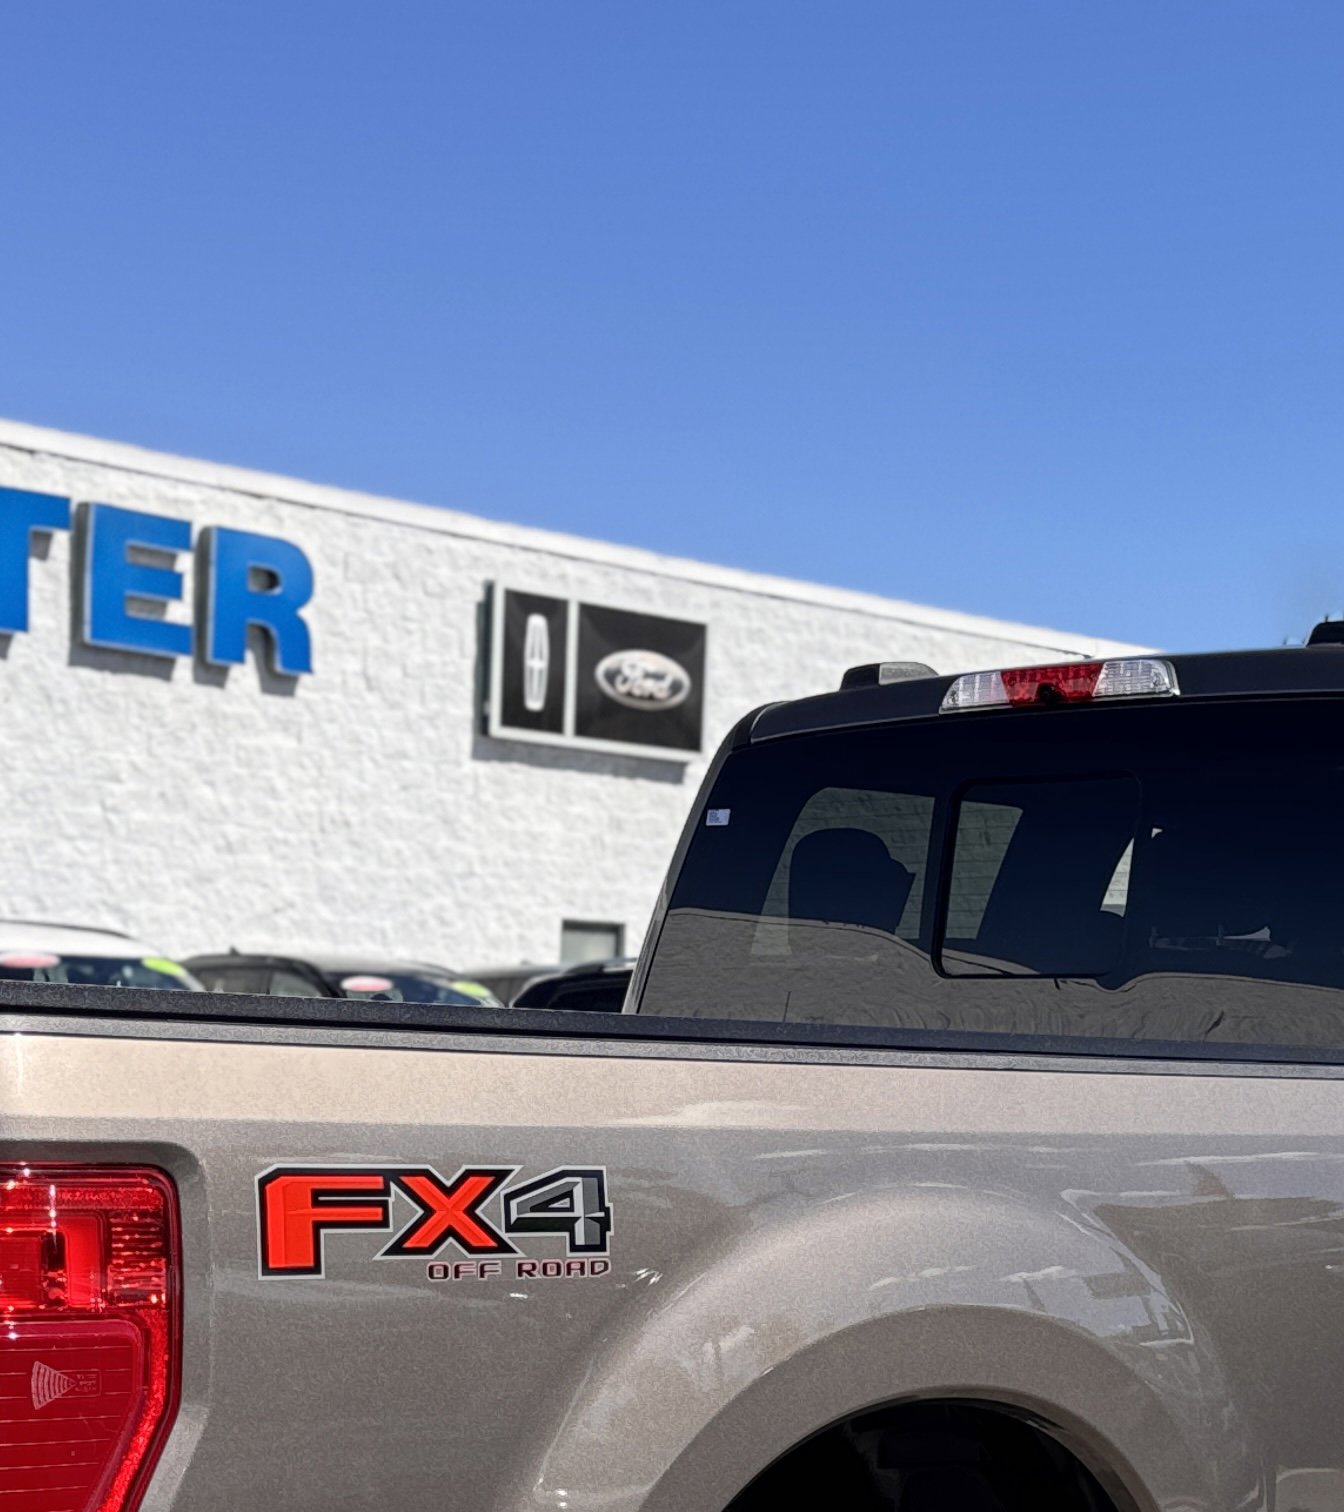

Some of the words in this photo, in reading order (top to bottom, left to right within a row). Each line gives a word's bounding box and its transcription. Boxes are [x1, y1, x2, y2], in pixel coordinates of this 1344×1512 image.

[256, 1163, 613, 1280] FX4
[427, 1260, 502, 1281] OFF
[516, 1258, 612, 1279] ROAD
